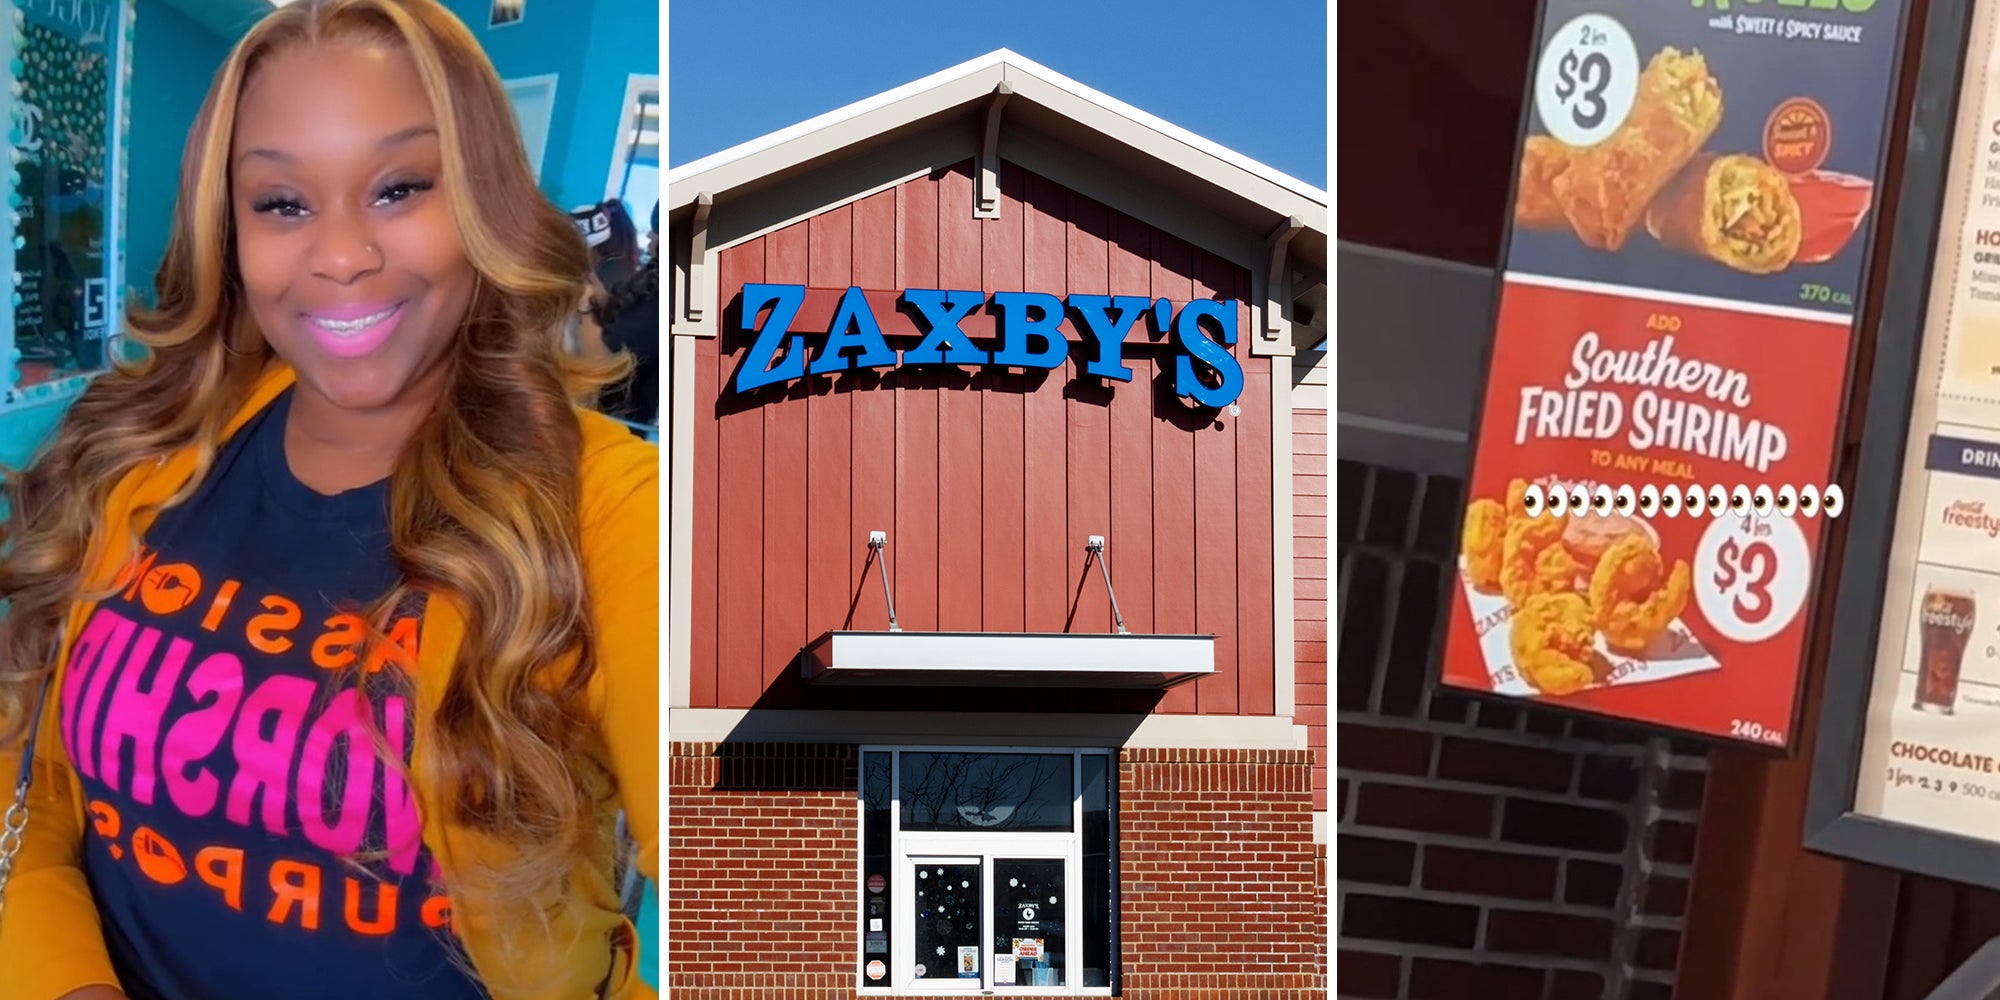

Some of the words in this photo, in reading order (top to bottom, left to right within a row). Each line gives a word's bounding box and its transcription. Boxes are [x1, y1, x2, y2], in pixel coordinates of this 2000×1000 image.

[1579, 24, 1590, 45] 2
[1736, 14, 1775, 35] SWEET
[1785, 19, 1823, 39] SPICY
[1823, 24, 1863, 43] SAUCE
[1555, 49, 1612, 130] $3
[1799, 283, 1831, 302] 370
[1646, 314, 1681, 332] ADD
[736, 282, 1244, 408] ZAXBY'S
[1564, 332, 1751, 408] Southern
[1515, 386, 1624, 445] FRIED
[1628, 390, 1788, 473] SHRIMP
[1590, 450, 1611, 467] TO
[1614, 456, 1649, 473] ANY
[1652, 460, 1695, 480] MEAL
[1740, 514, 1751, 534] 4
[1714, 536, 1777, 624] $3
[1731, 719, 1762, 739] 240
[1763, 729, 1785, 744] CAL
[1891, 741, 1993, 773] CHOCOLATE
